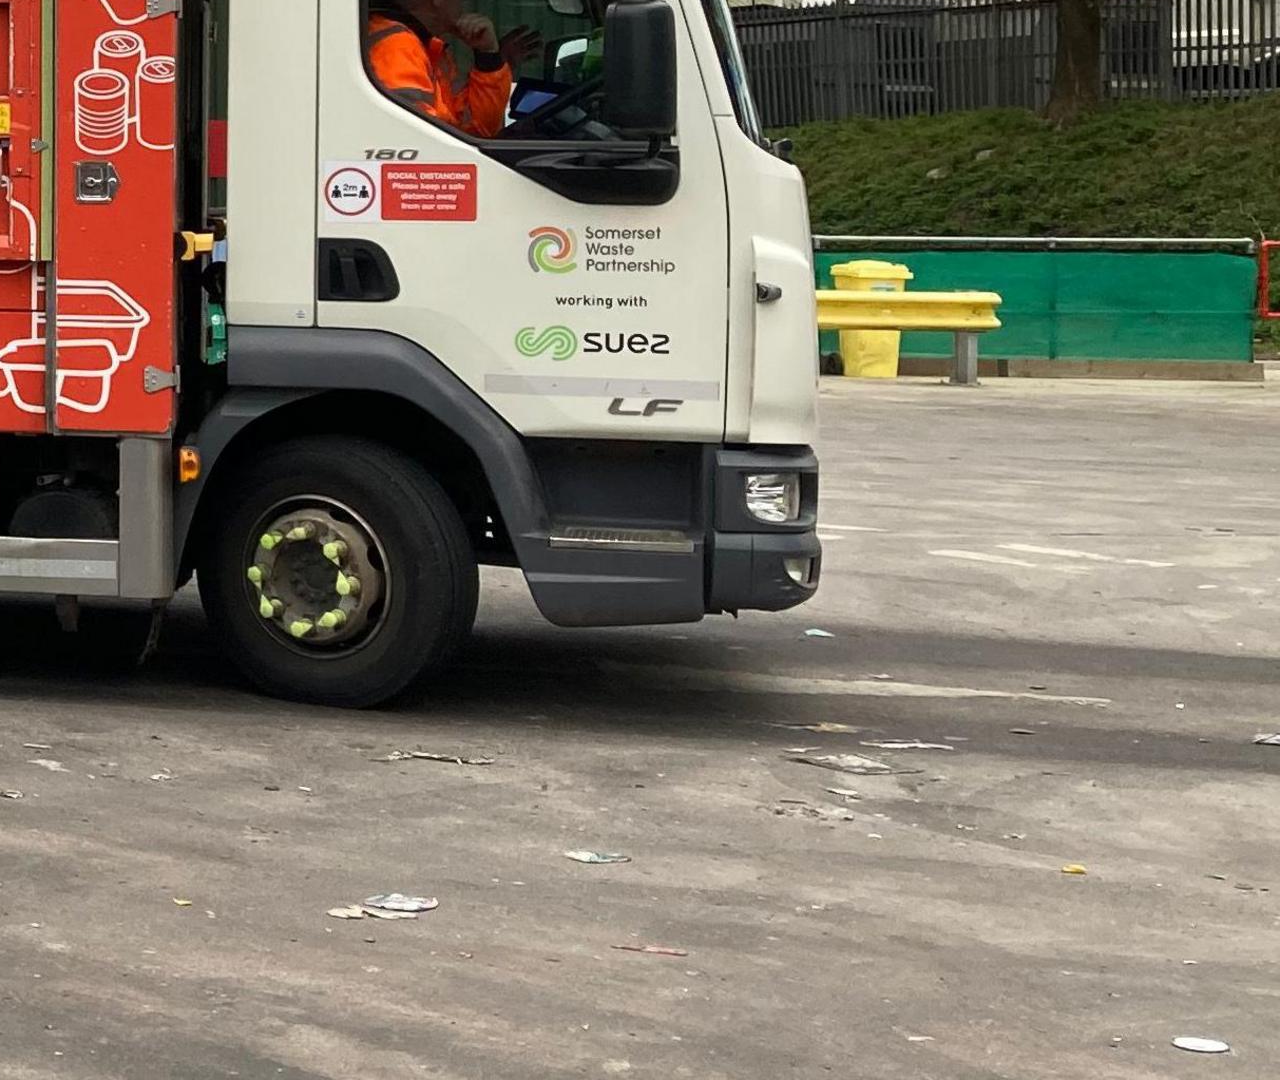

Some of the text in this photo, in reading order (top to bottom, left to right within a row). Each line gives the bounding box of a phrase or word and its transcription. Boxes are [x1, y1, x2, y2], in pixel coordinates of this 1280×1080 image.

[364, 148, 419, 161] 180
[387, 172, 471, 181] SOCIAL DISTANCING
[585, 225, 661, 240] Somerset
[585, 243, 635, 256] Waste
[585, 258, 676, 275] Partnership
[555, 294, 648, 309] working with
[607, 397, 684, 417] LF
